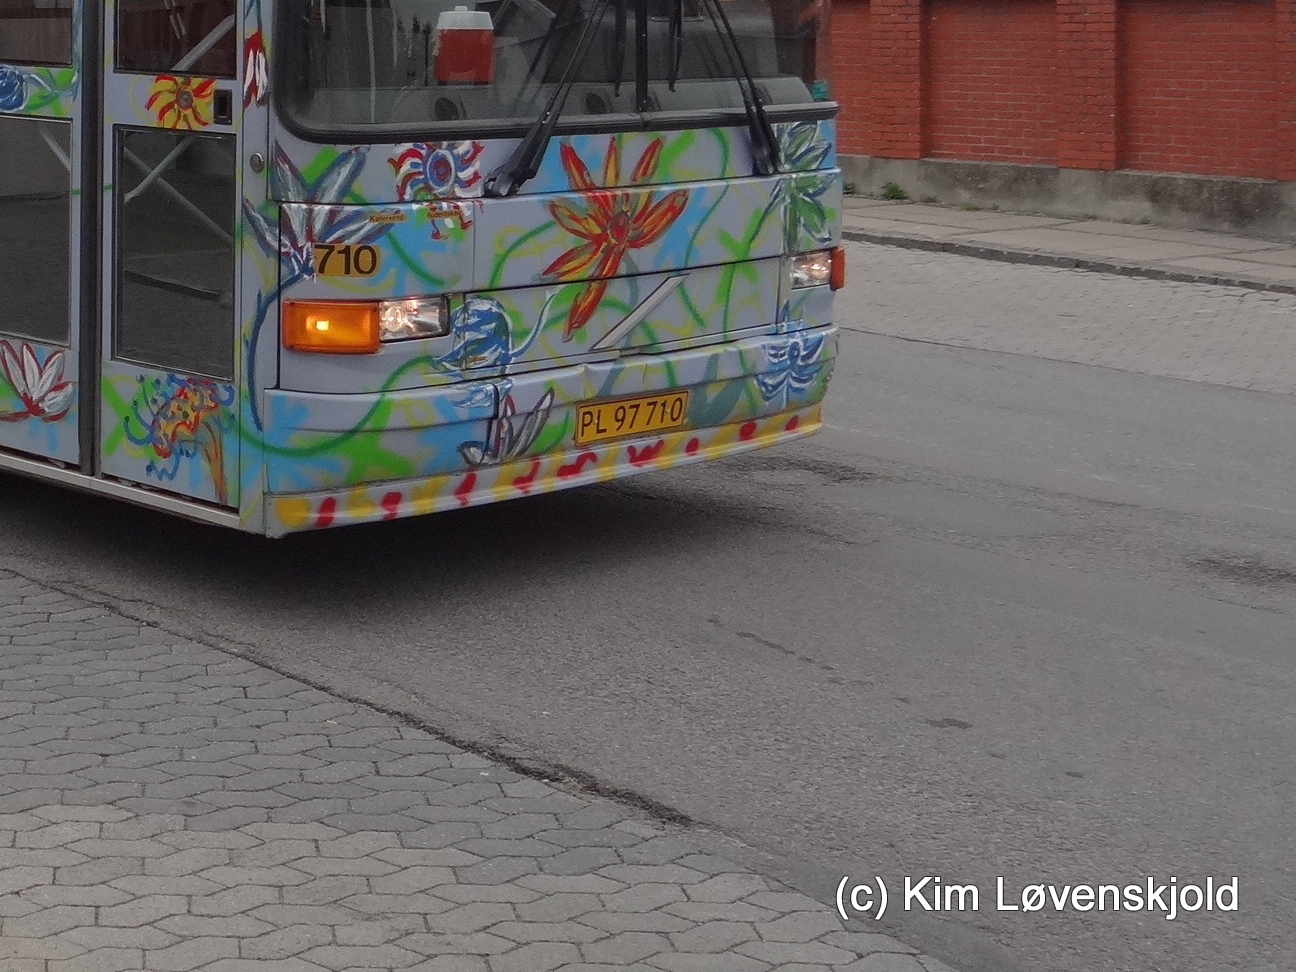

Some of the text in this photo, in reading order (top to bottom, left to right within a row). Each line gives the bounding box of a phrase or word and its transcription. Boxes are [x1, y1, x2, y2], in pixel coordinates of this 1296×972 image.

[314, 244, 377, 274] 710
[581, 397, 683, 437] PL 97 710
